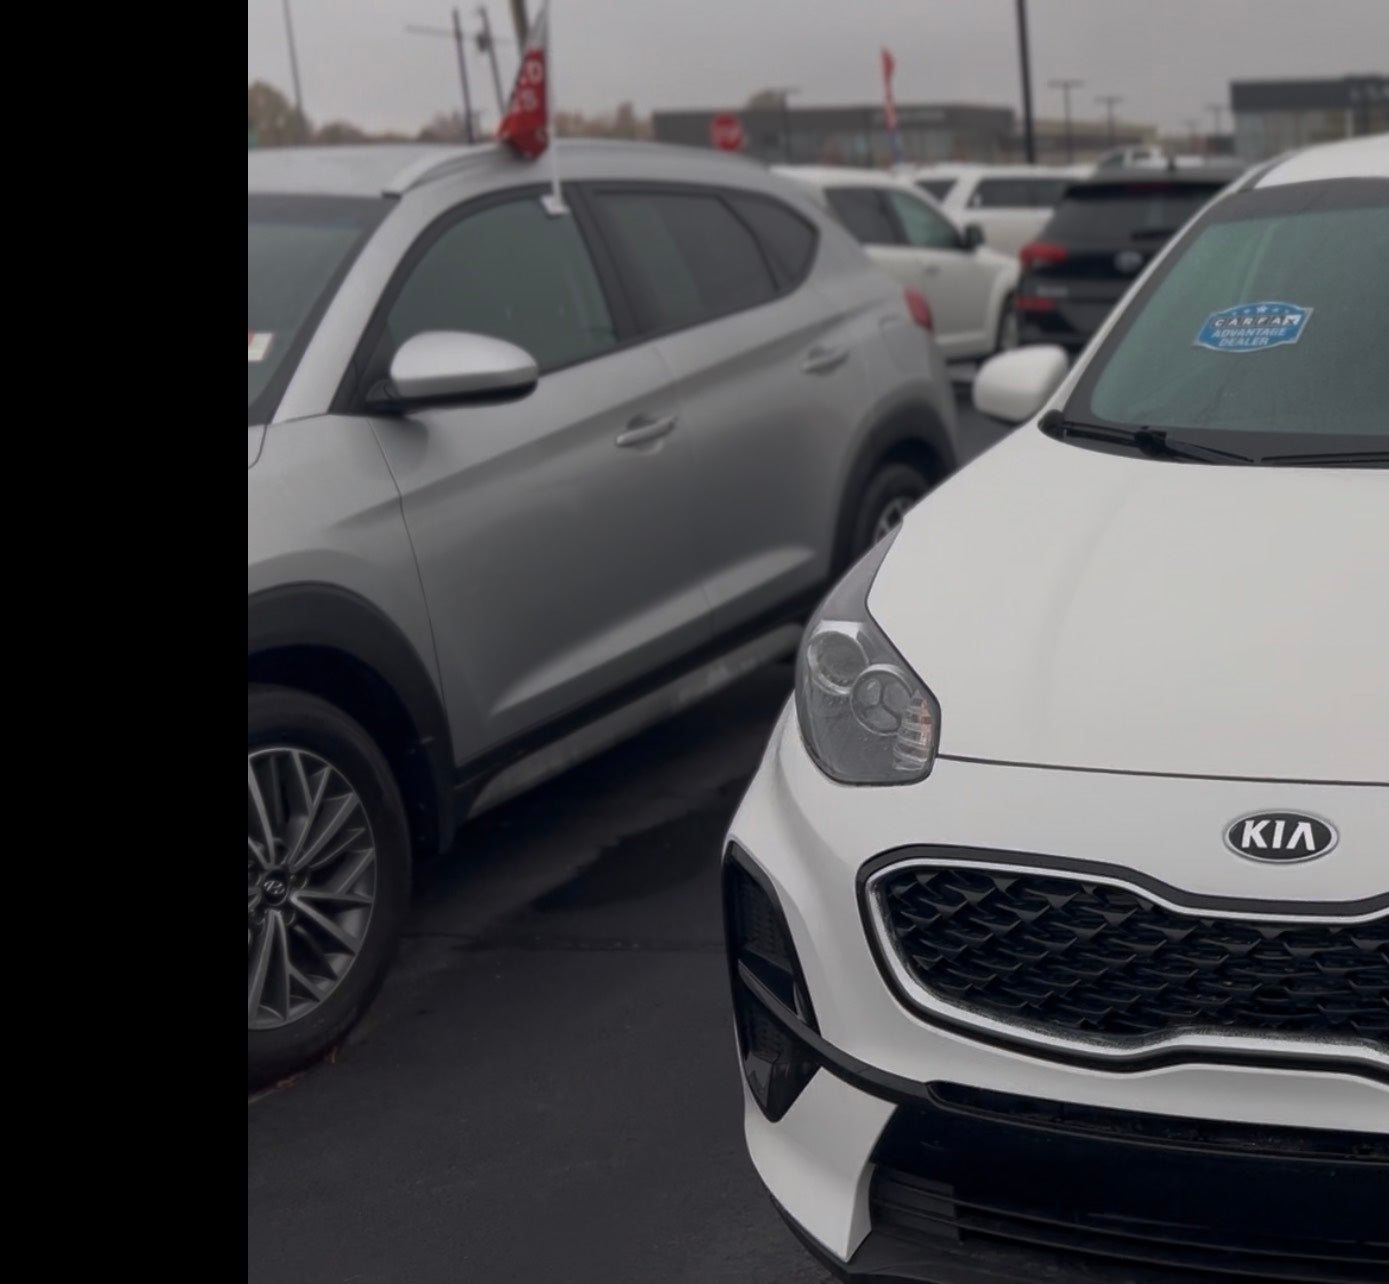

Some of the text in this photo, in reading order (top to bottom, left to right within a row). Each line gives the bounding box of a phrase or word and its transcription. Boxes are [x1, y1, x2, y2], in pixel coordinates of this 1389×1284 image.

[1213, 314, 1302, 327] CARFAX
[1210, 327, 1288, 339] ADVANTAGE
[1218, 337, 1270, 347] DEALER
[1241, 820, 1316, 851] KIA
